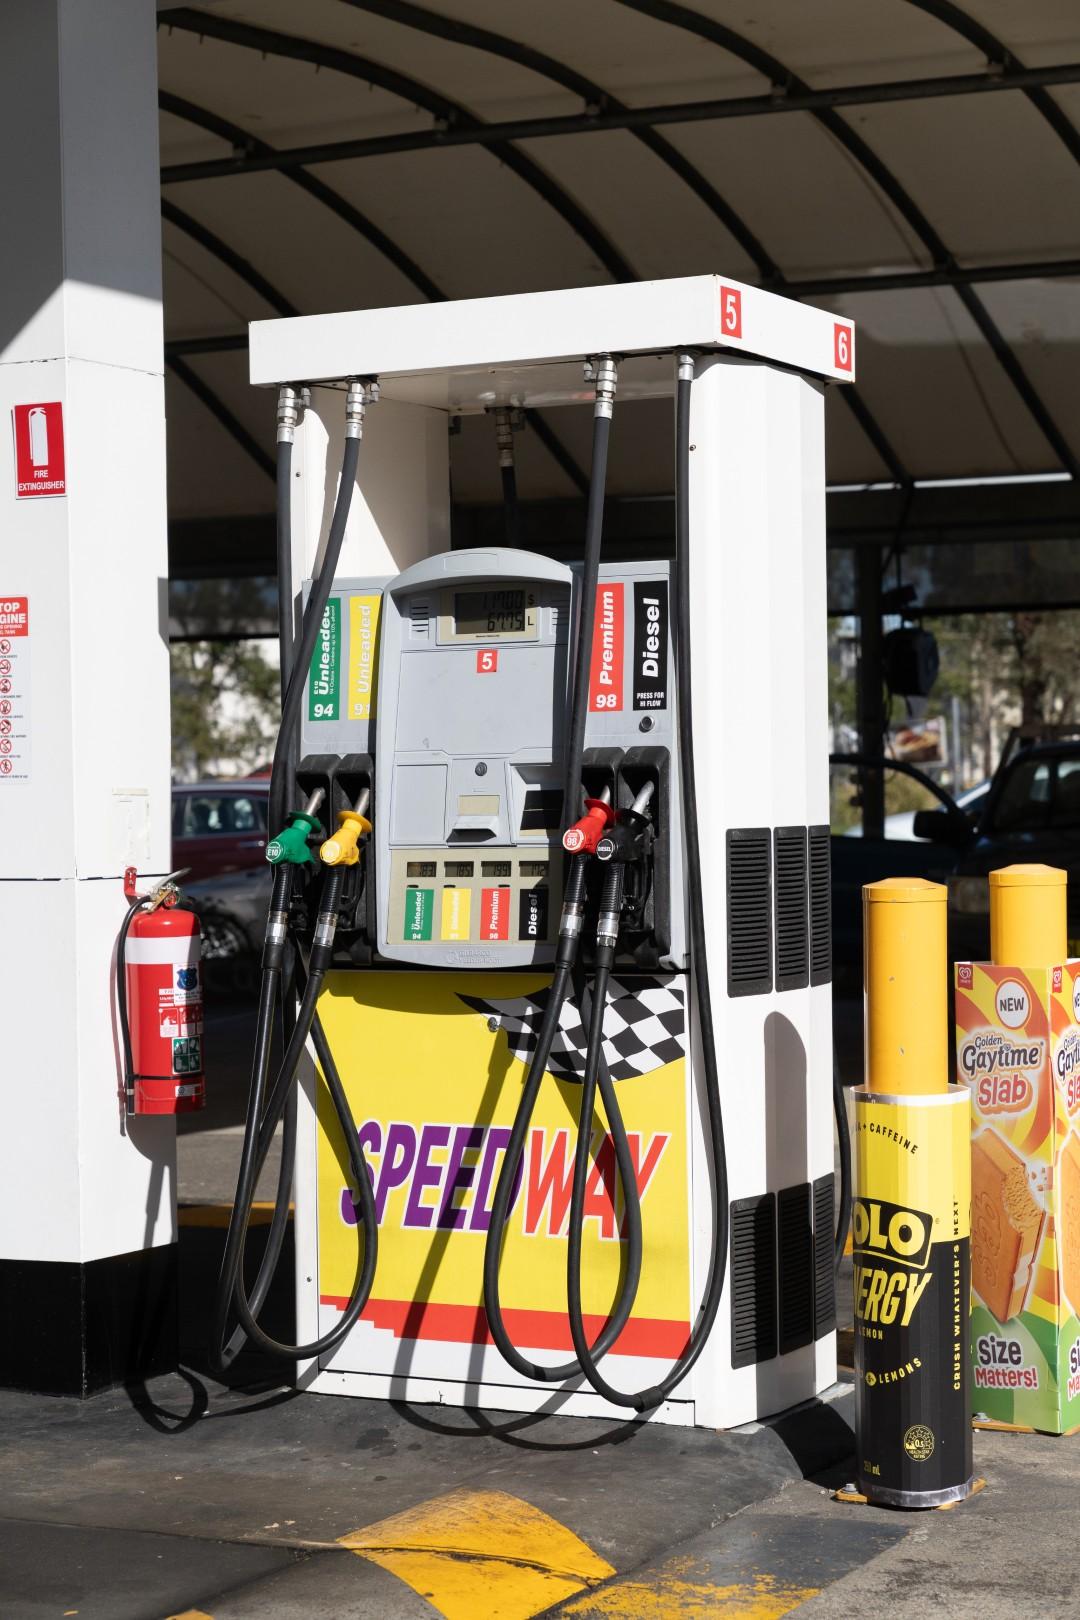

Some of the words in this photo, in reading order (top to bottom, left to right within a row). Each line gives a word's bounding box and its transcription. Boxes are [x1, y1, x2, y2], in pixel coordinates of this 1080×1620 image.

[725, 294, 737, 330] 5
[838, 330, 848, 365] 6
[18, 480, 64, 491] EXTINGUISHER
[34, 470, 48, 478] FIRE
[528, 616, 534, 626] L
[358, 605, 371, 693] Unleaded
[600, 592, 614, 685] Premium
[642, 598, 660, 678] Diesel
[482, 652, 492, 670] 5
[314, 704, 334, 717] 94
[596, 694, 617, 708] 98
[566, 838, 578, 846] 98
[490, 891, 499, 930] Premium
[528, 893, 538, 934] Diesel
[1000, 997, 1024, 1012] NEW
[974, 1036, 1002, 1049] Golden
[962, 1045, 1038, 1076] Gaytime
[978, 1074, 1026, 1106] Slab
[870, 1122, 918, 1154] CAFFEINE
[340, 1119, 671, 1240] SPEEDWAY
[854, 1264, 933, 1326] ERGY
[978, 1335, 1022, 1366] Size
[879, 1358, 922, 1384] LEMONS
[976, 1368, 1038, 1387] Matters!
